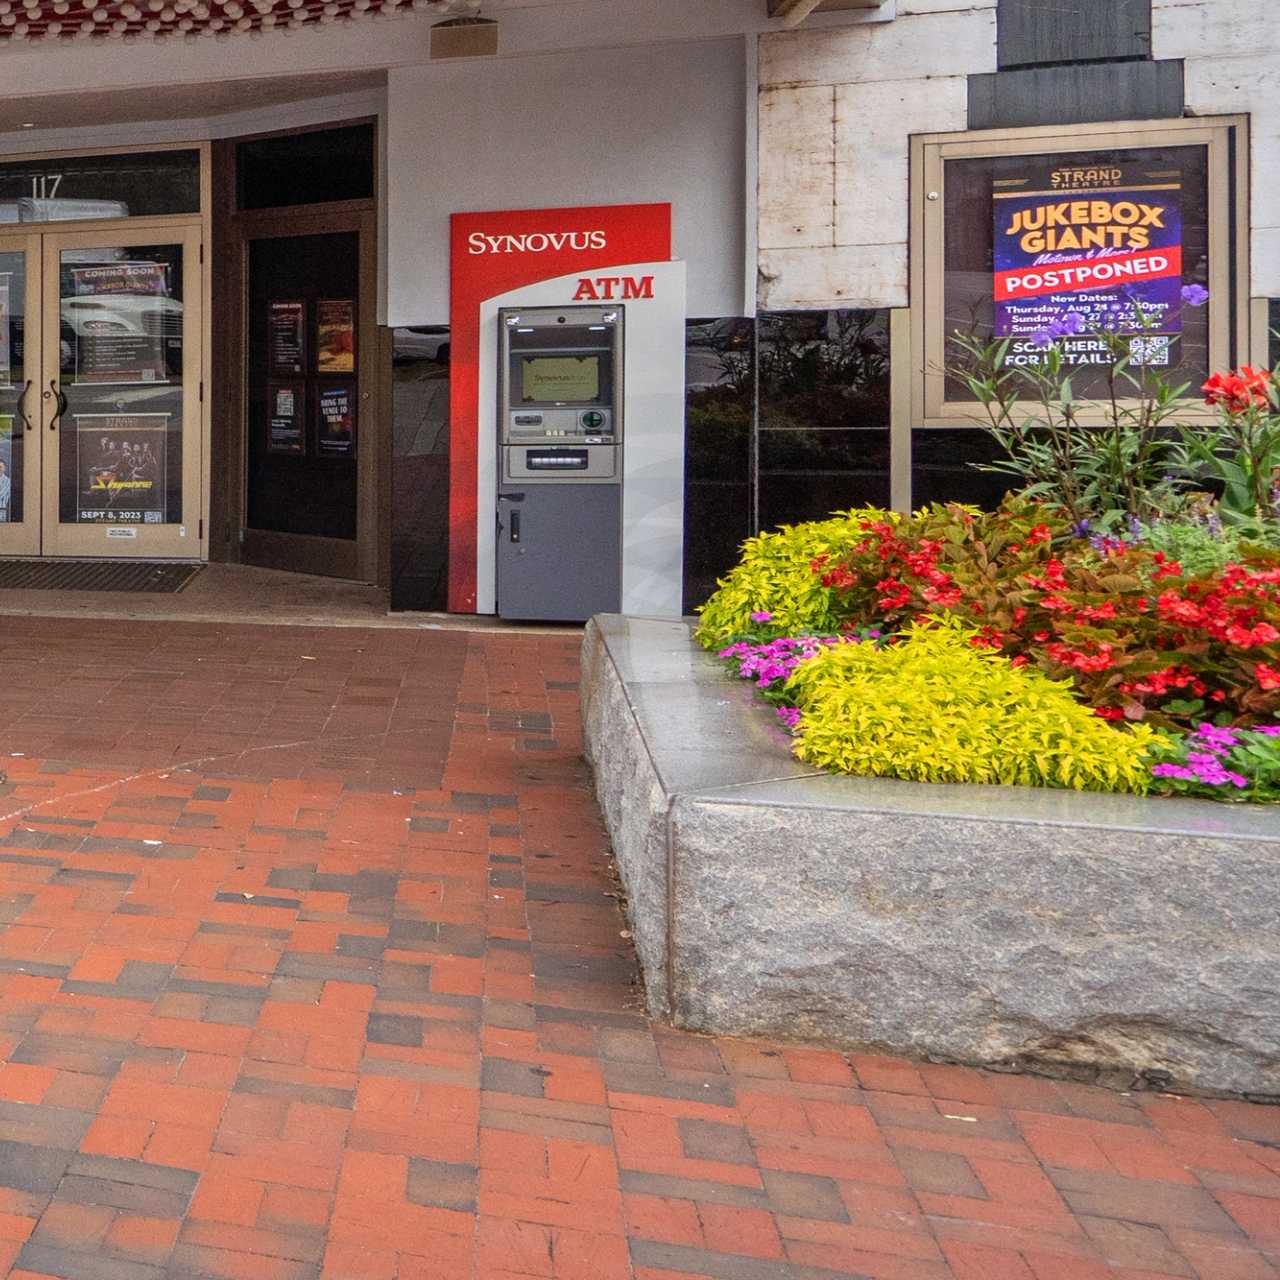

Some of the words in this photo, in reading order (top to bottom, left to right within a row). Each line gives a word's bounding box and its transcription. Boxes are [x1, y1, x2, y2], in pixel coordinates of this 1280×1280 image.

[1051, 169, 1122, 183] STRAND
[32, 174, 63, 200] 117
[1051, 180, 1121, 188] THEATRE
[1006, 200, 1166, 235] JUKEBOX
[468, 231, 607, 255] SYNOVUS
[1020, 225, 1150, 254] GIANTS
[1033, 253, 1083, 267] Motown
[85, 269, 125, 278] COMING
[127, 267, 154, 276] SOON
[1005, 256, 1168, 293] POSTPONED
[572, 275, 655, 301] ATM
[1051, 295, 1077, 303] New
[1079, 294, 1118, 302] Dates:
[1005, 304, 1064, 313] Thursday,
[1067, 304, 1091, 313] Aug
[1088, 313, 1101, 321] 27
[81, 511, 106, 519] SEPT
[119, 511, 142, 519] 2023
